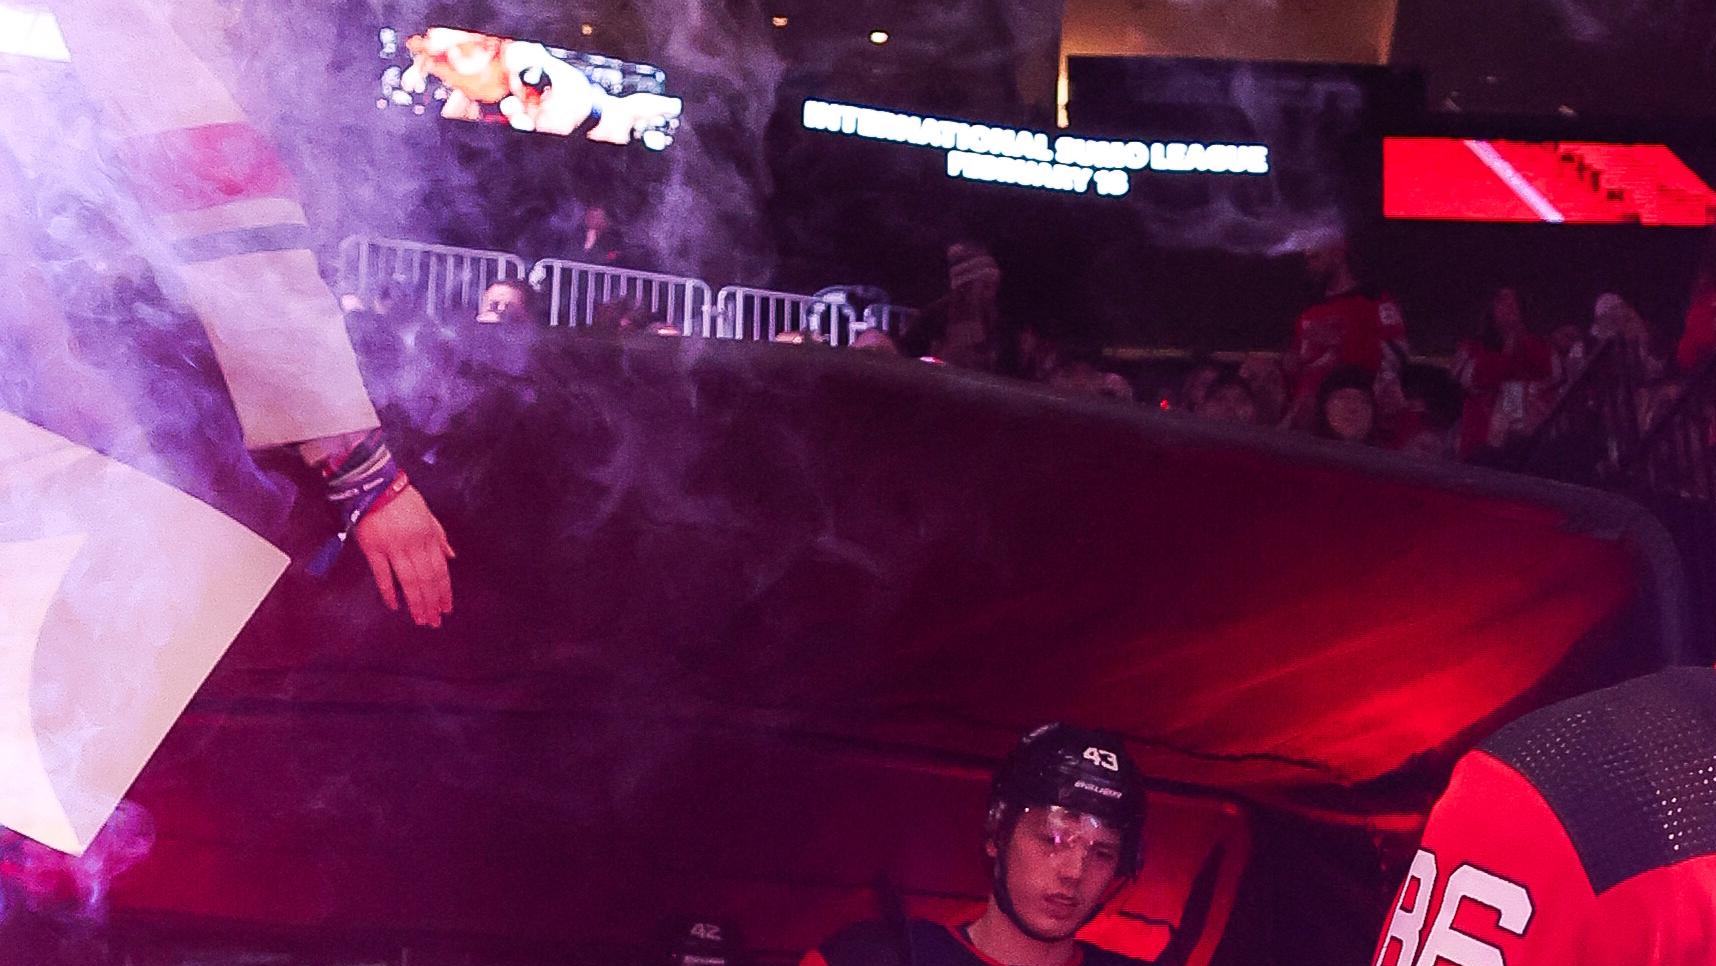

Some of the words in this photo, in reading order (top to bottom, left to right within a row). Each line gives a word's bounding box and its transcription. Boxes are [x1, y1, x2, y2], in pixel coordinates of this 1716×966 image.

[804, 100, 1053, 161] INTERNATIONAL
[1054, 136, 1149, 169] SUMO
[1150, 142, 1268, 173] LEAGUE
[947, 150, 1093, 193] FEBRUARY
[1083, 747, 1118, 771] 43
